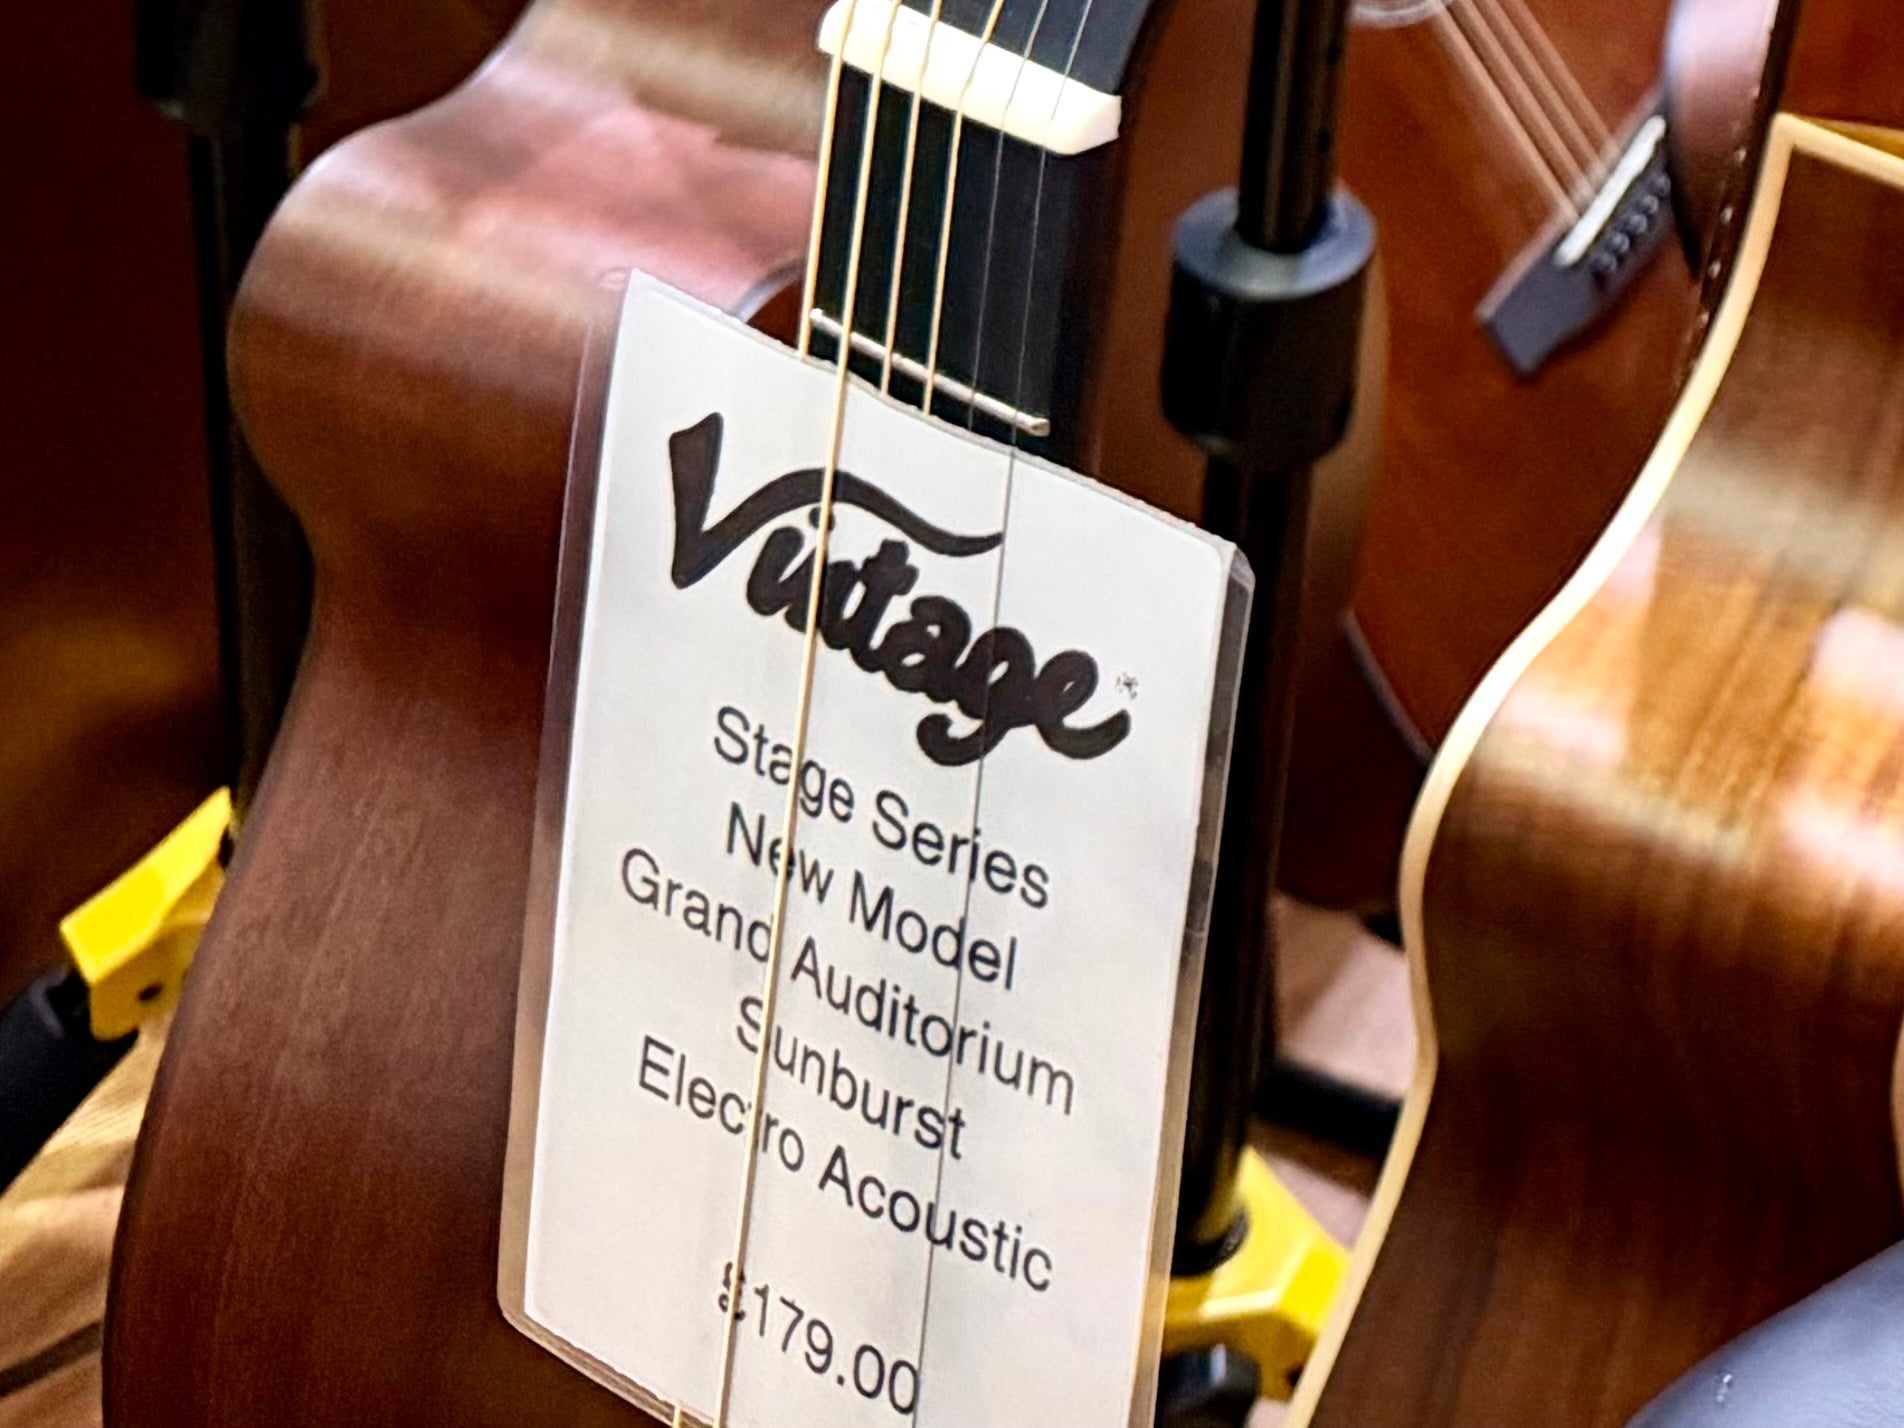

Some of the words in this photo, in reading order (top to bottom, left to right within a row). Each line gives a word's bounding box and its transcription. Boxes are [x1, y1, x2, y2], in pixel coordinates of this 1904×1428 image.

[668, 411, 1132, 767] Vintage
[713, 706, 855, 824] Stage
[872, 789, 1051, 911] Series
[726, 801, 836, 904] New
[849, 870, 1019, 991] Model
[736, 995, 967, 1162] Sunburst
[790, 935, 1076, 1116] Auditorium
[638, 1034, 805, 1173] Elecro
[818, 1144, 1053, 1293] Acoustic
[717, 1260, 920, 1416] £179.00
